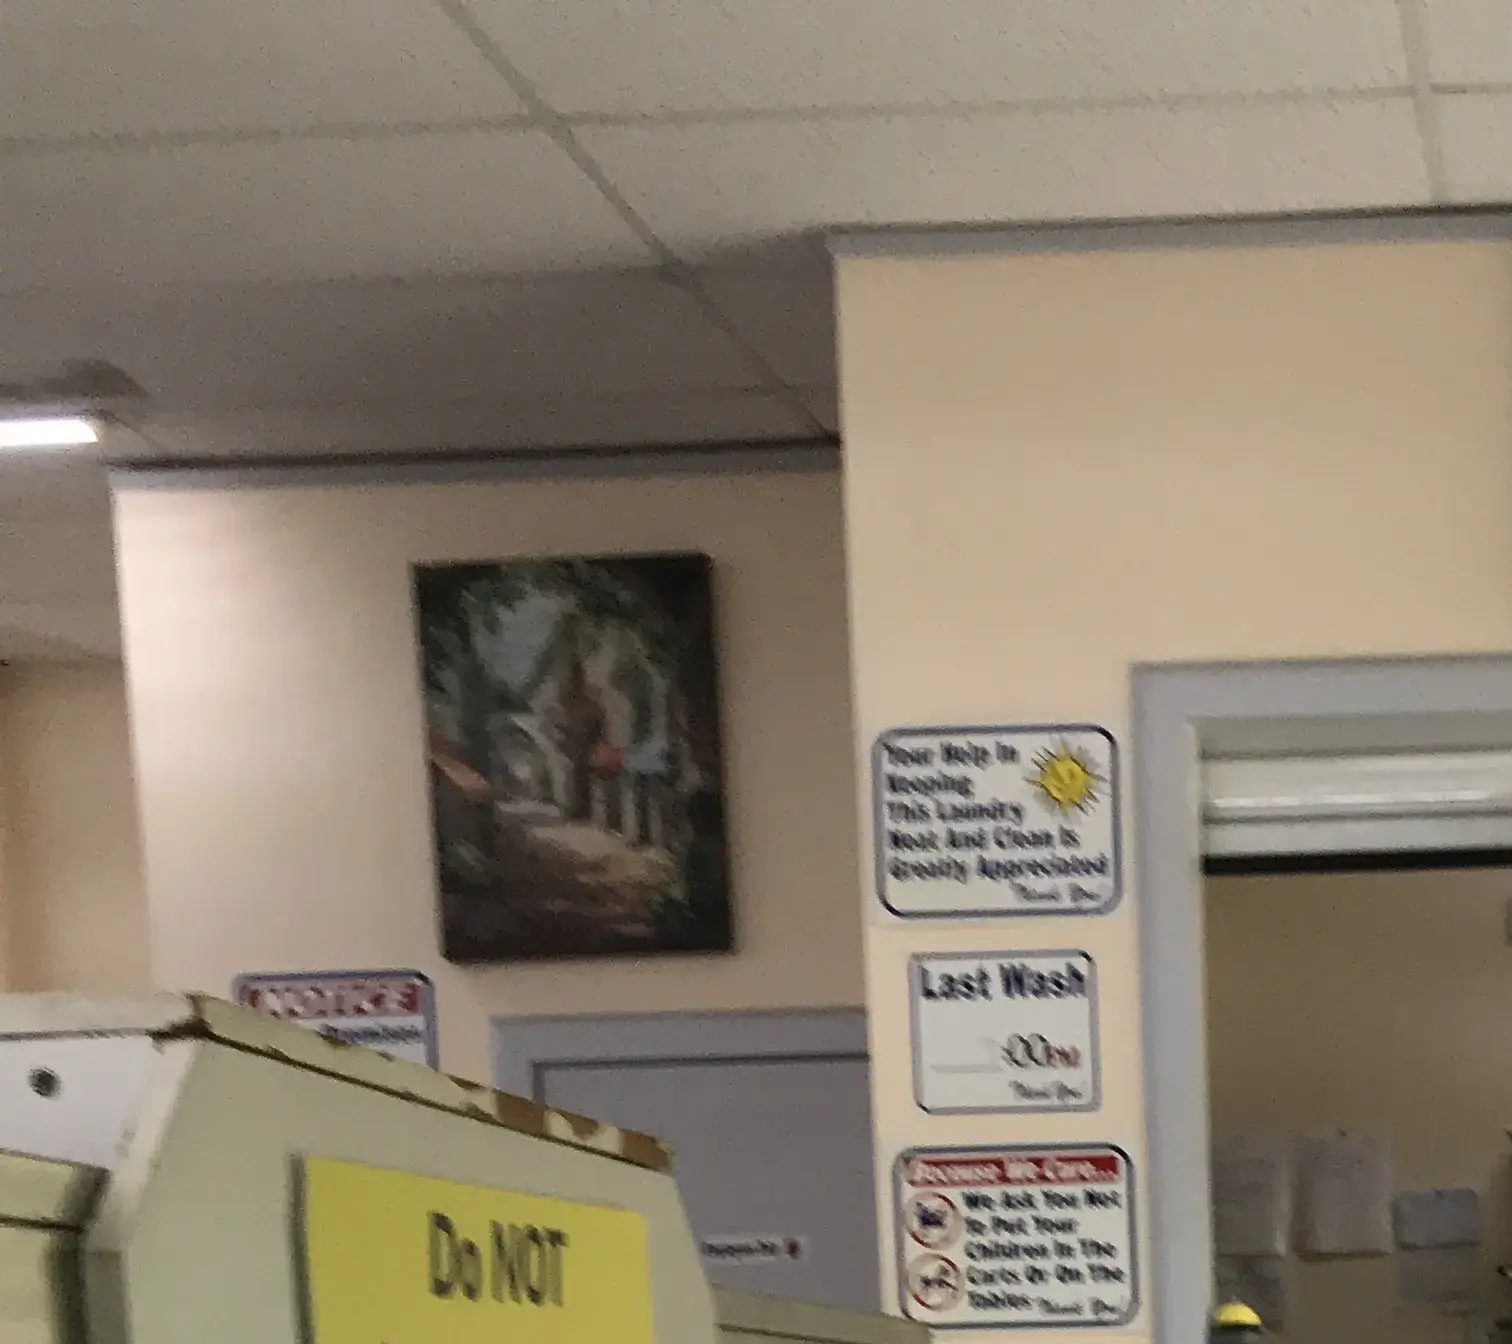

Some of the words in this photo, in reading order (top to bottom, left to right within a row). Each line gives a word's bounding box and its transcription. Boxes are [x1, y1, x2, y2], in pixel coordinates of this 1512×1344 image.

[886, 801, 930, 823] This
[936, 799, 1024, 826] Laundry
[994, 826, 1055, 849] Clean
[977, 853, 1108, 880] Appreciated
[918, 963, 992, 1000] Last
[998, 961, 1086, 998] Wash
[426, 1211, 482, 1303] Do
[491, 1220, 571, 1308] NOT
[964, 1239, 1050, 1261] Children
